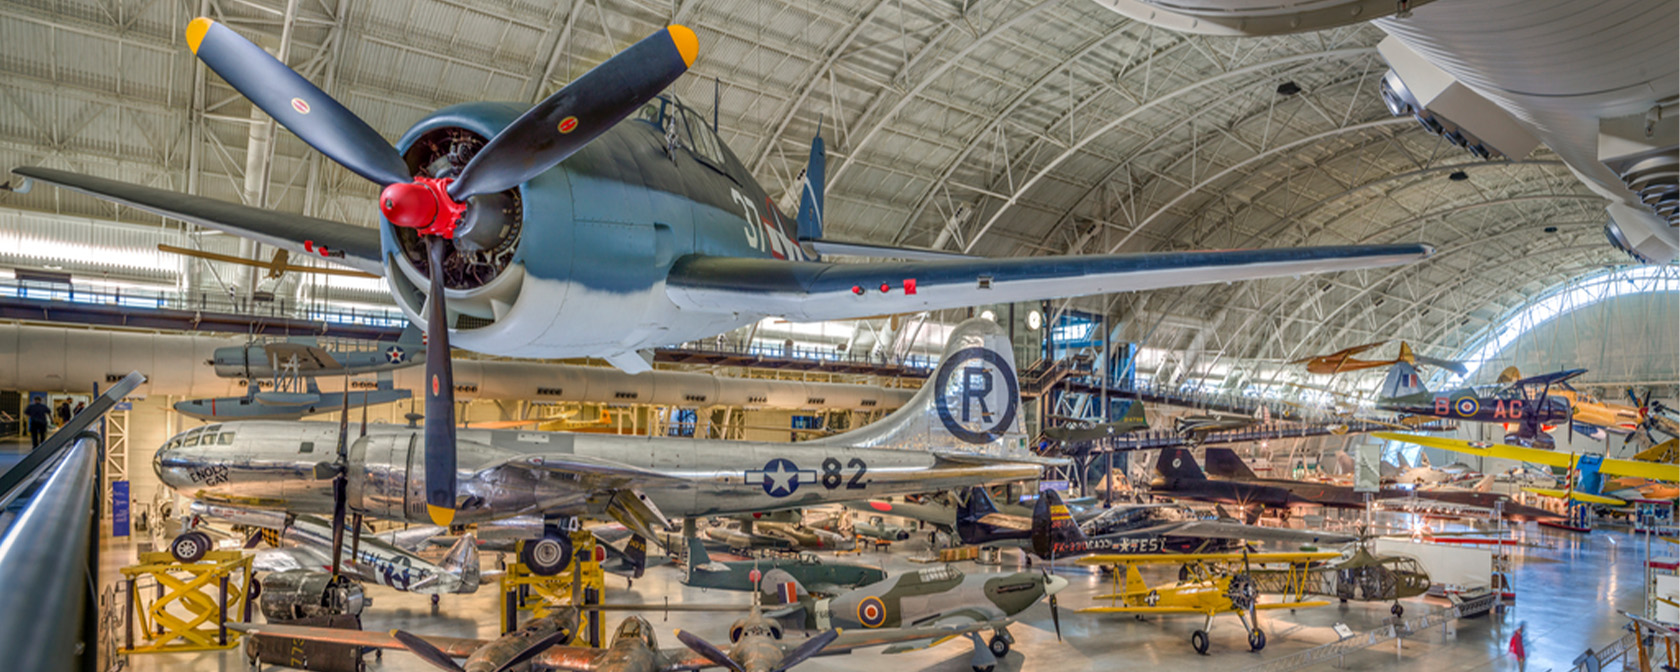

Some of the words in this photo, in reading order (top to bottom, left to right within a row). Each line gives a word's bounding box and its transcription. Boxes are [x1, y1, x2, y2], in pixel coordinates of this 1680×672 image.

[962, 367, 993, 423] R
[1435, 397, 1450, 415] B
[1494, 399, 1522, 418] AC
[190, 464, 229, 483] ENOLA
[206, 474, 229, 487] GAY
[822, 457, 866, 490] 82
